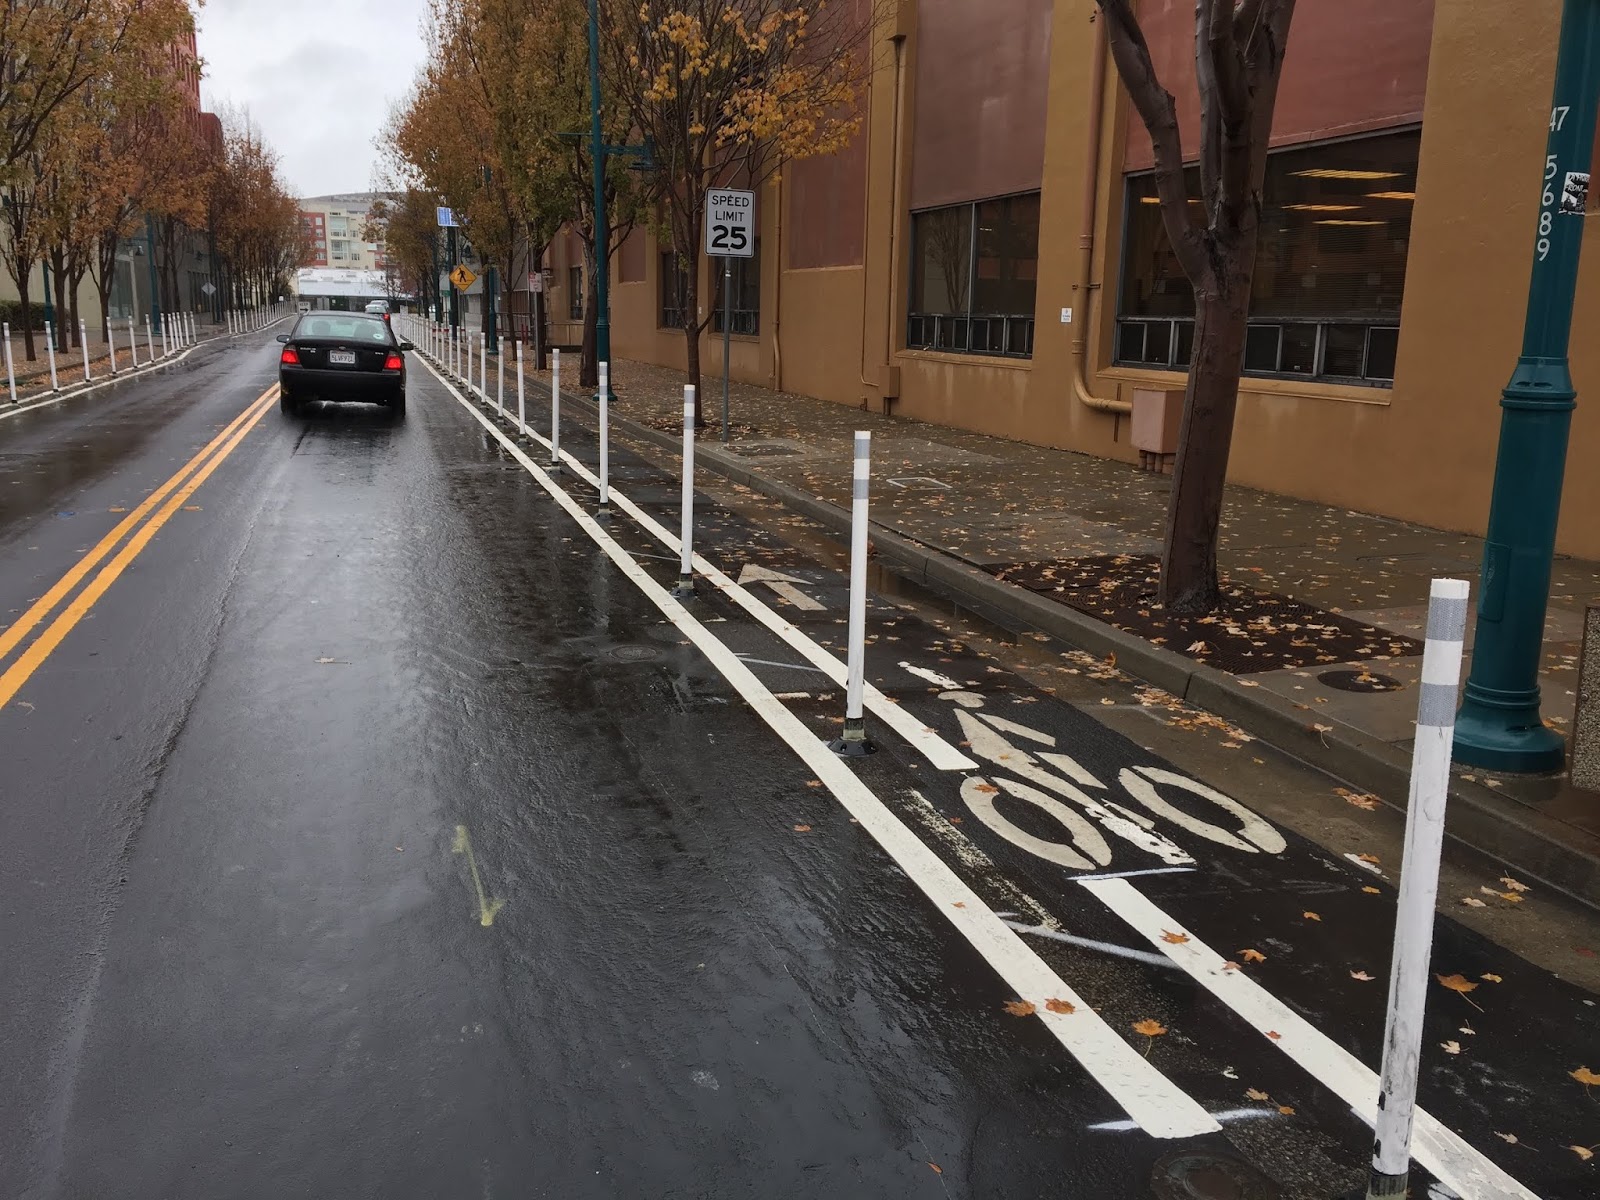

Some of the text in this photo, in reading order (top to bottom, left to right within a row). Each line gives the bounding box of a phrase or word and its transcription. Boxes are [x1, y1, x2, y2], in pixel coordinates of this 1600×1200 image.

[1549, 106, 1570, 132] 47
[712, 195, 749, 207] SPEED
[715, 210, 745, 222] LIMIT
[712, 225, 747, 250] 25
